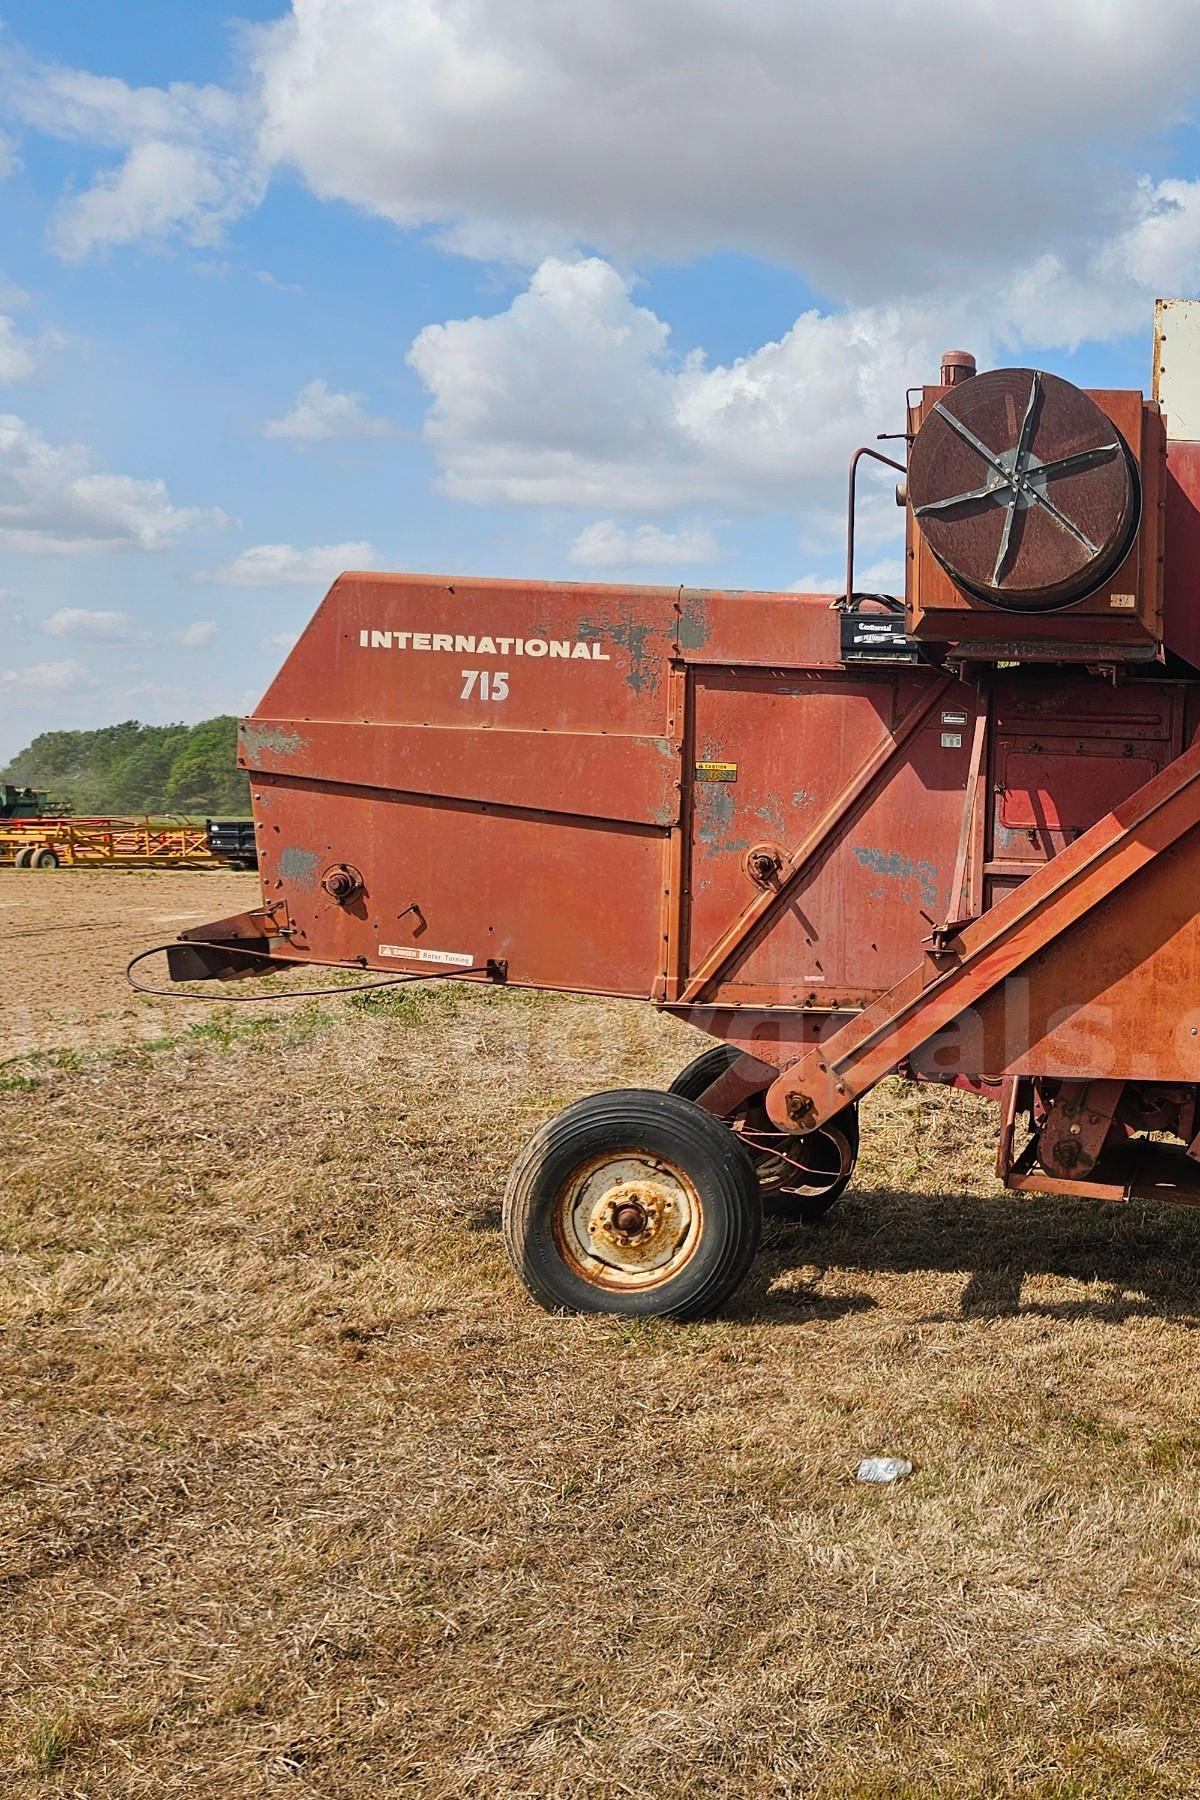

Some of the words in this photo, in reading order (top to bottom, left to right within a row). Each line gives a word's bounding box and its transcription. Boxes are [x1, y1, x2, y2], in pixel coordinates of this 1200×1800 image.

[858, 622, 892, 632] Continental
[359, 629, 610, 661] INTERNATIONAL
[459, 670, 509, 701] 715
[393, 948, 417, 958] DANGER
[422, 951, 441, 960] Rotor
[445, 953, 470, 964] Turning
